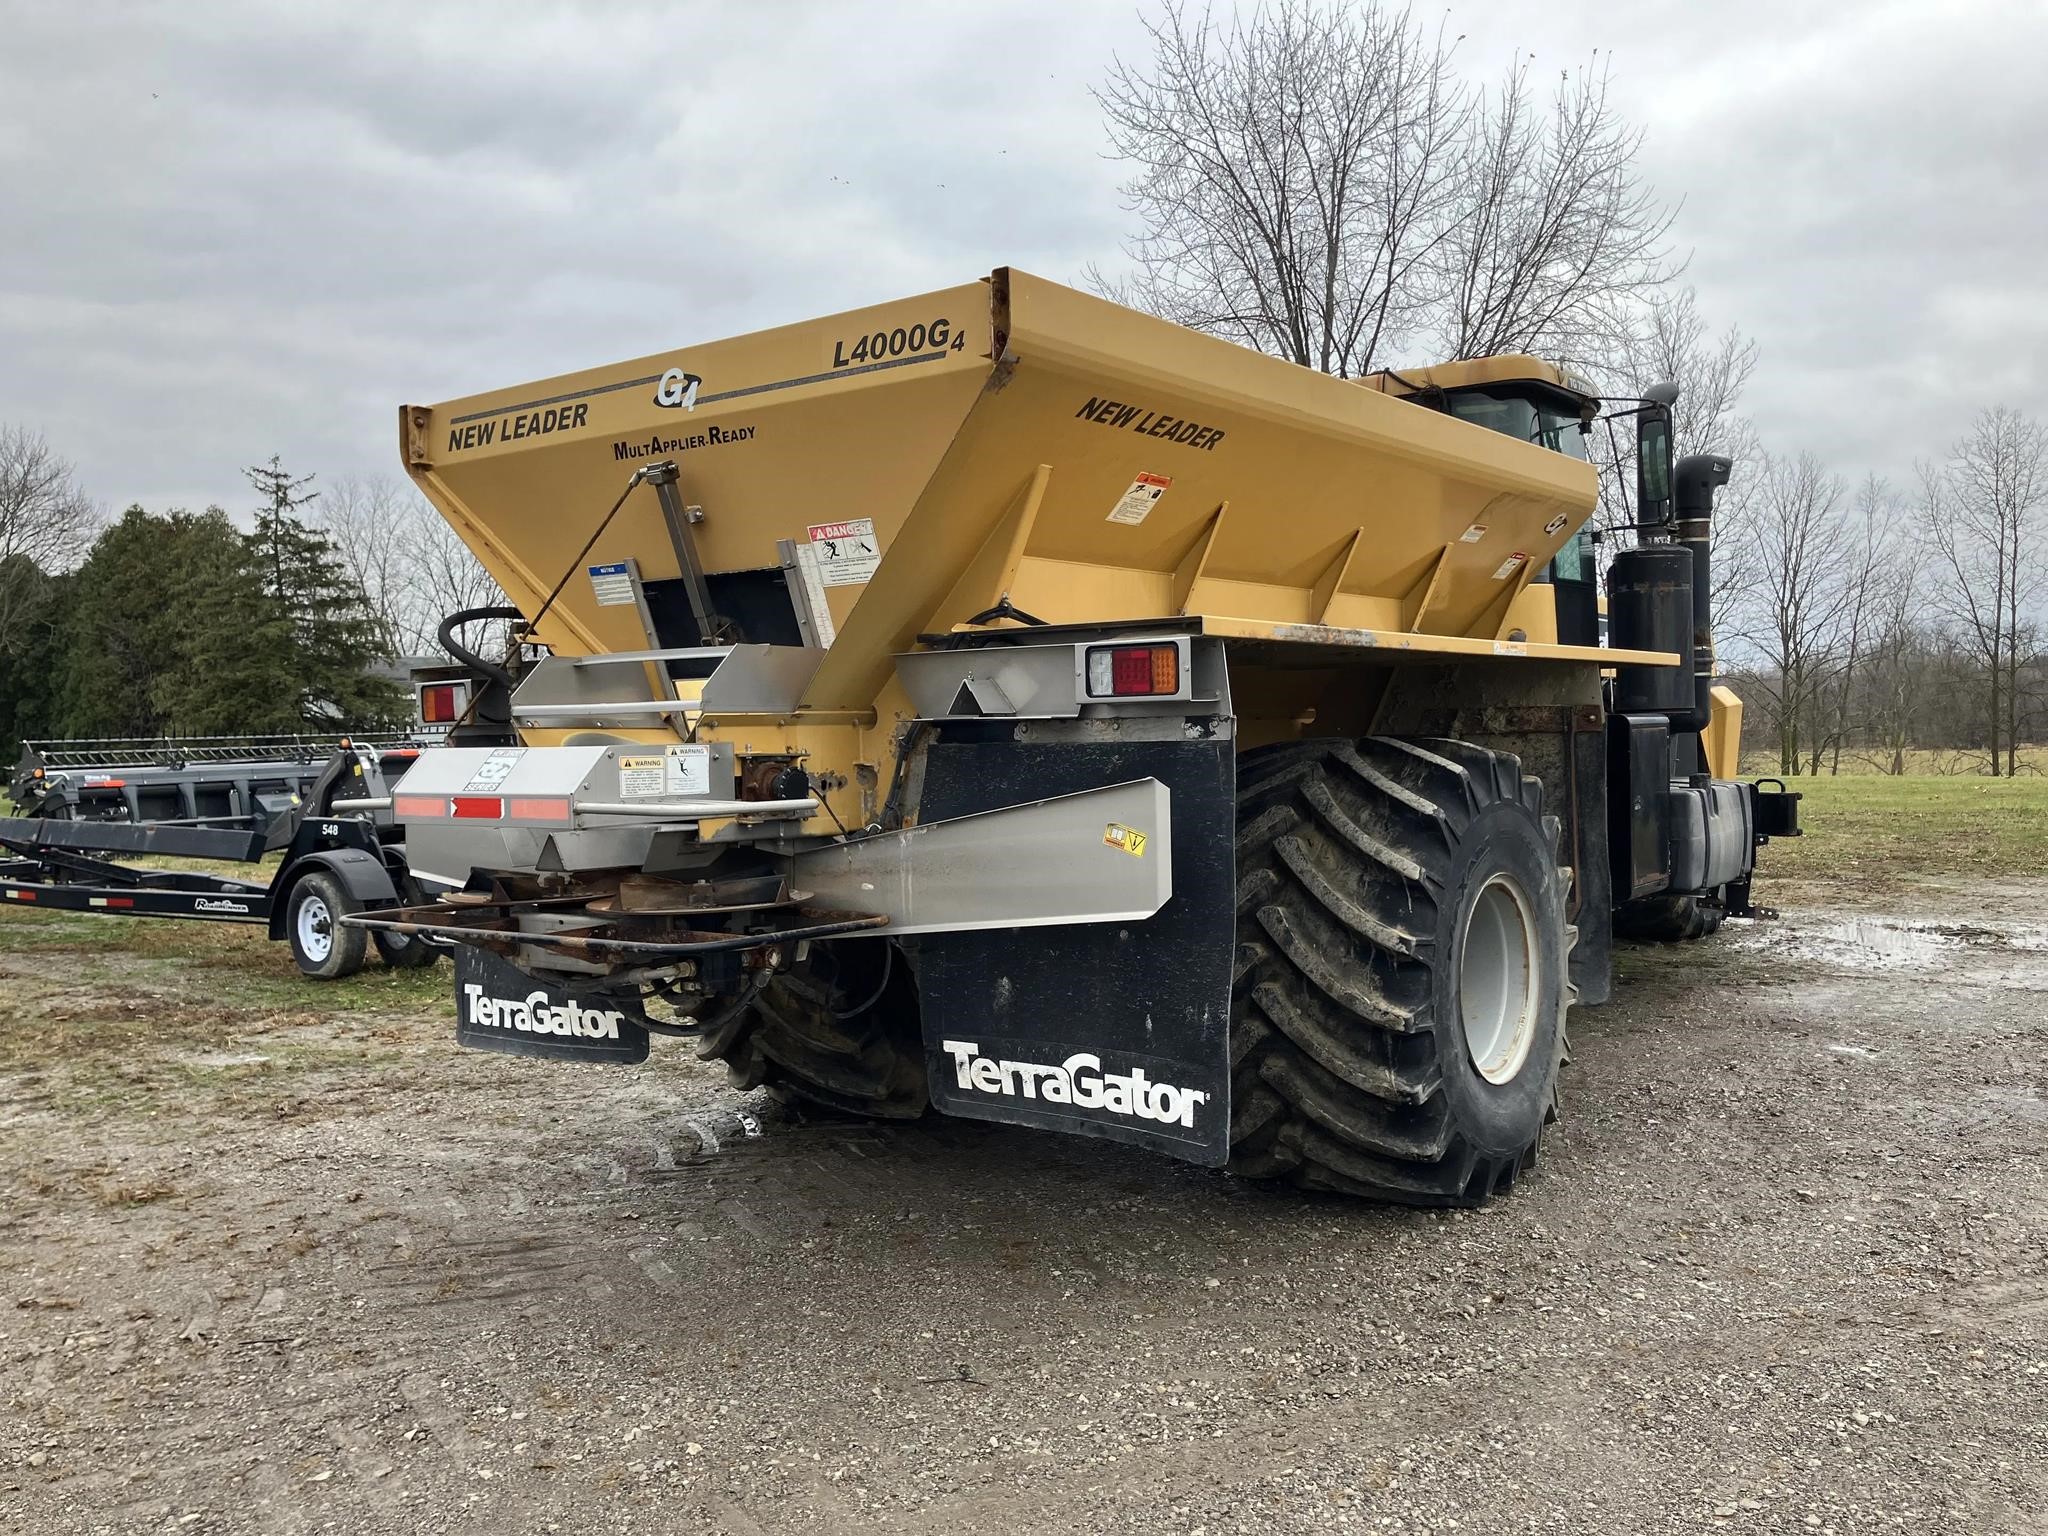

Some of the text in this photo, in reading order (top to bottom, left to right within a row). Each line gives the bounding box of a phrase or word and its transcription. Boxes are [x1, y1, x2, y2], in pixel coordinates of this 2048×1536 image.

[833, 318, 965, 368] L4000G4
[657, 367, 699, 412] G4
[448, 403, 588, 452] NEW LEADER
[1075, 396, 1225, 451] NEW LEADER
[322, 824, 339, 835] 548
[464, 983, 625, 1039] TerraGator
[943, 1040, 1205, 1128] TerraGator
